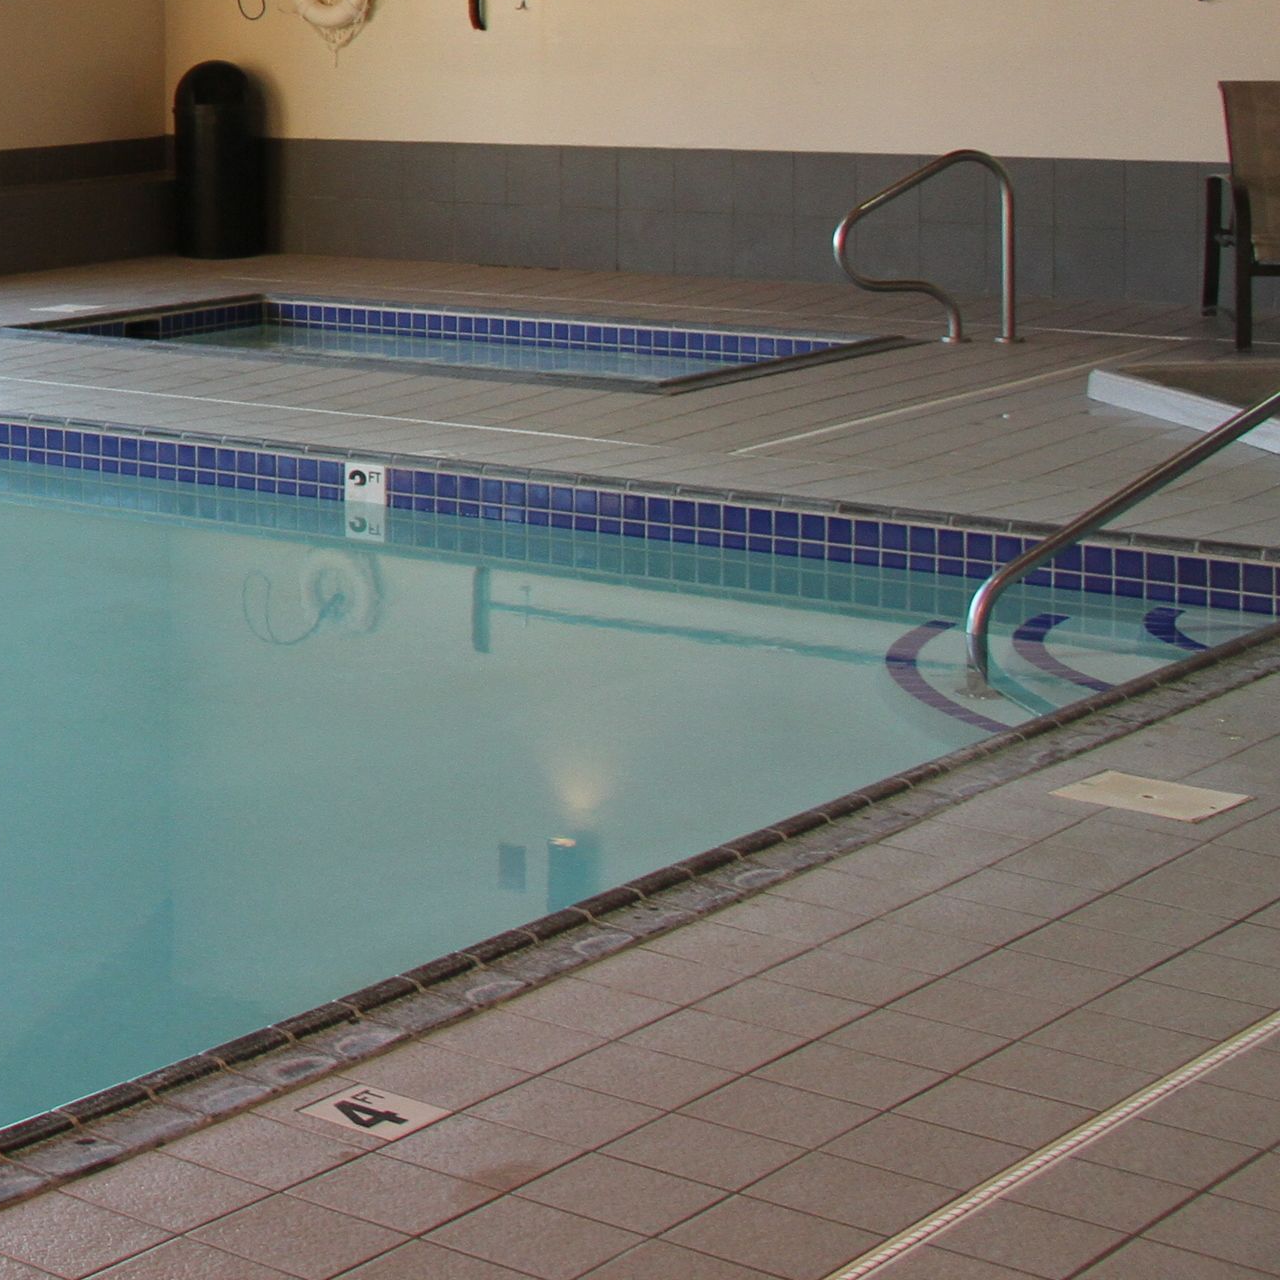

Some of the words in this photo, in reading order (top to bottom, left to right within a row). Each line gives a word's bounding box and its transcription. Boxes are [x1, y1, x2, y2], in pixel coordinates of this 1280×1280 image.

[368, 471, 382, 484] FT
[351, 1089, 385, 1105] FT
[333, 1100, 409, 1128] 4
